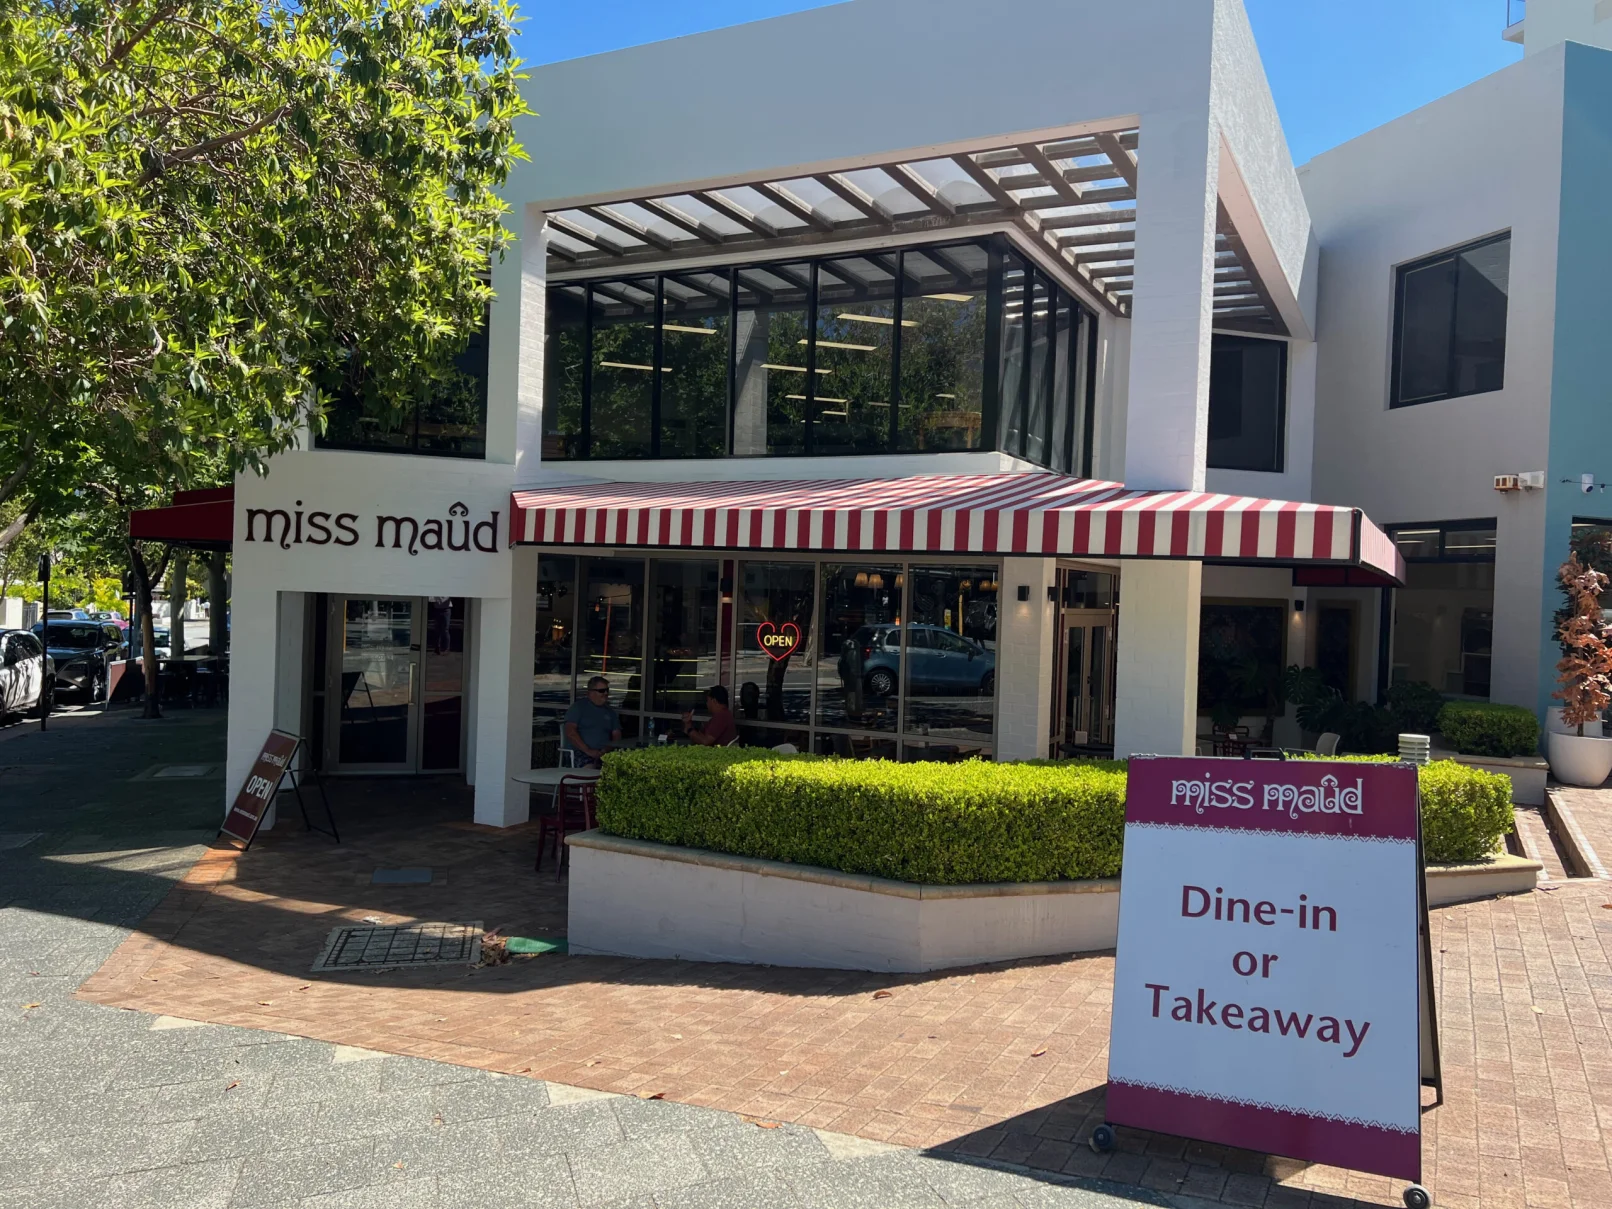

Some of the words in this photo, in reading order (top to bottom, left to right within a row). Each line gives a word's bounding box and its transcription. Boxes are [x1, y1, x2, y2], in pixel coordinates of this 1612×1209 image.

[245, 500, 359, 549] miss
[763, 635, 793, 647] OPEN
[246, 775, 273, 799] OPEN
[1170, 772, 1254, 814] miss
[1180, 884, 1338, 932] Dine-in
[1232, 950, 1279, 978] or
[1144, 983, 1371, 1058] Takeaway
